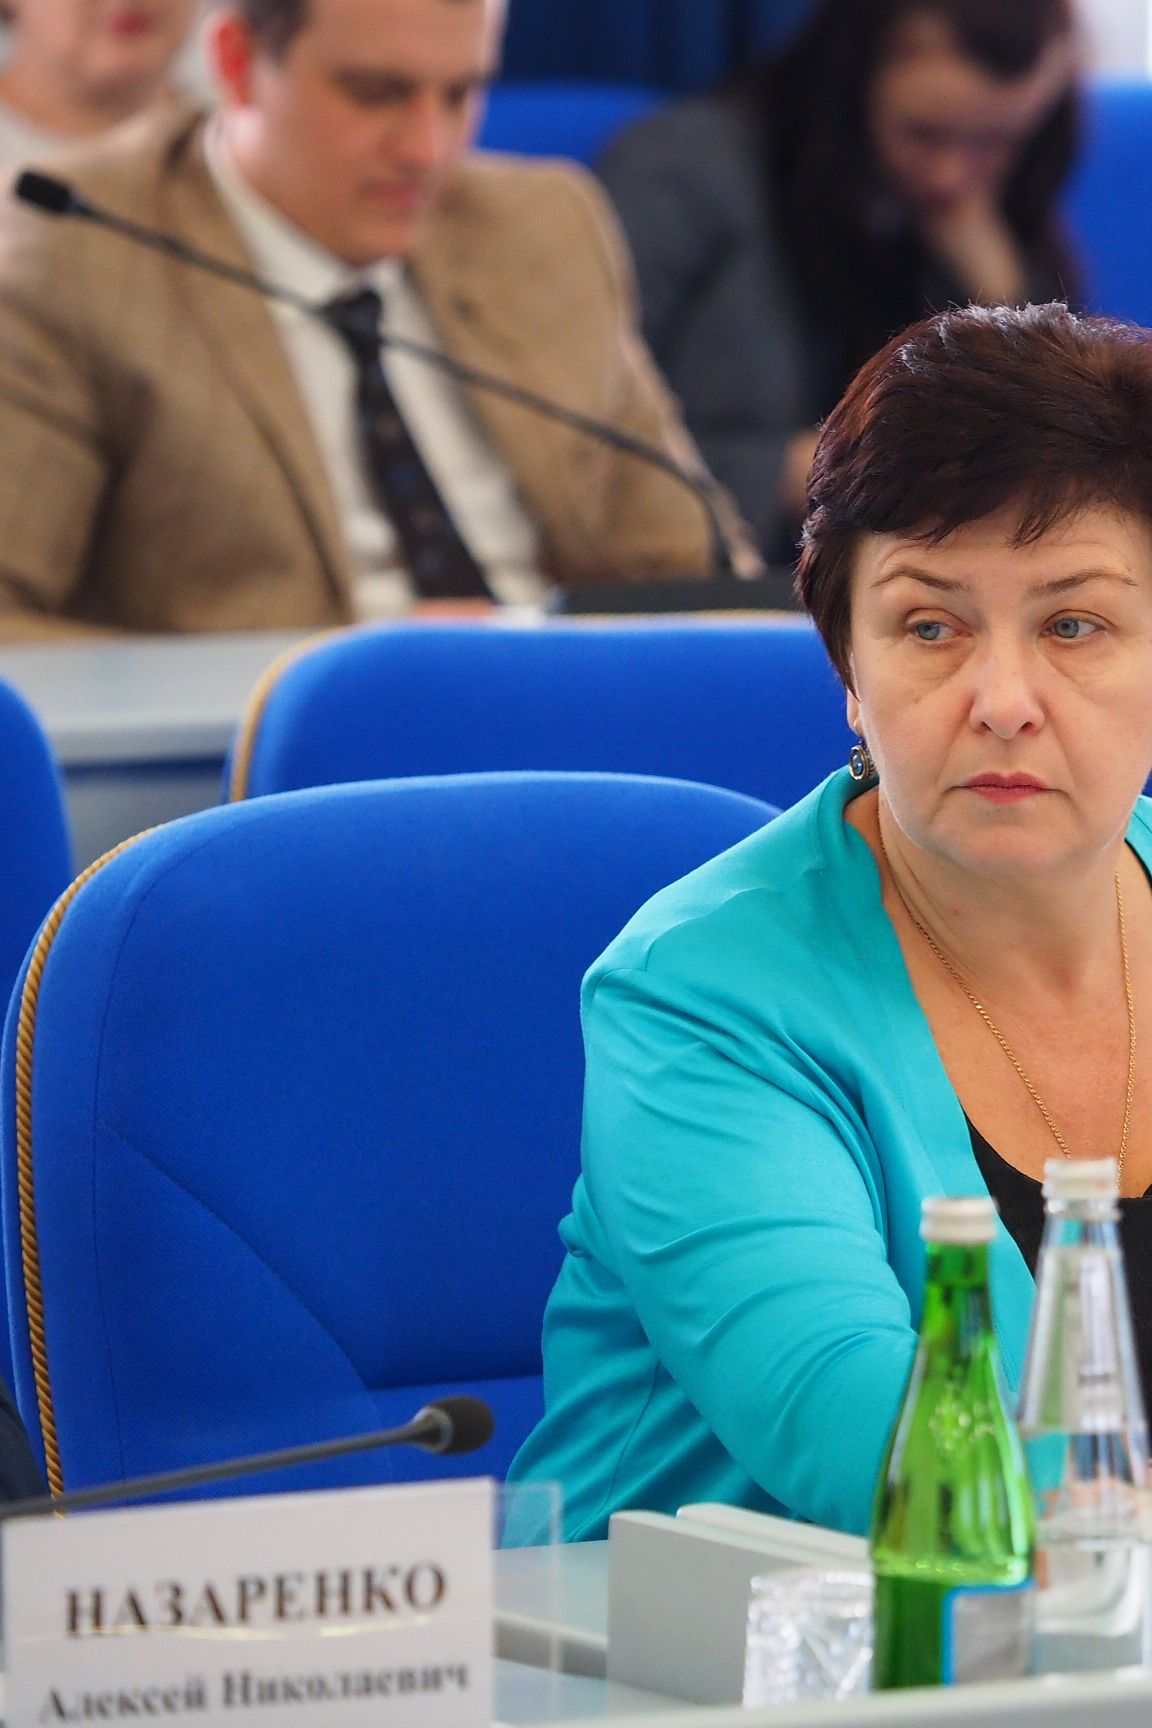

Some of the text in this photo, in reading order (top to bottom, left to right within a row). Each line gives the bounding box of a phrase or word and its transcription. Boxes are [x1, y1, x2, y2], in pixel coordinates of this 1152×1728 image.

[64, 1561, 448, 1639] НАЗАРЕНКО
[40, 1660, 470, 1724] Алексей Николаевич
